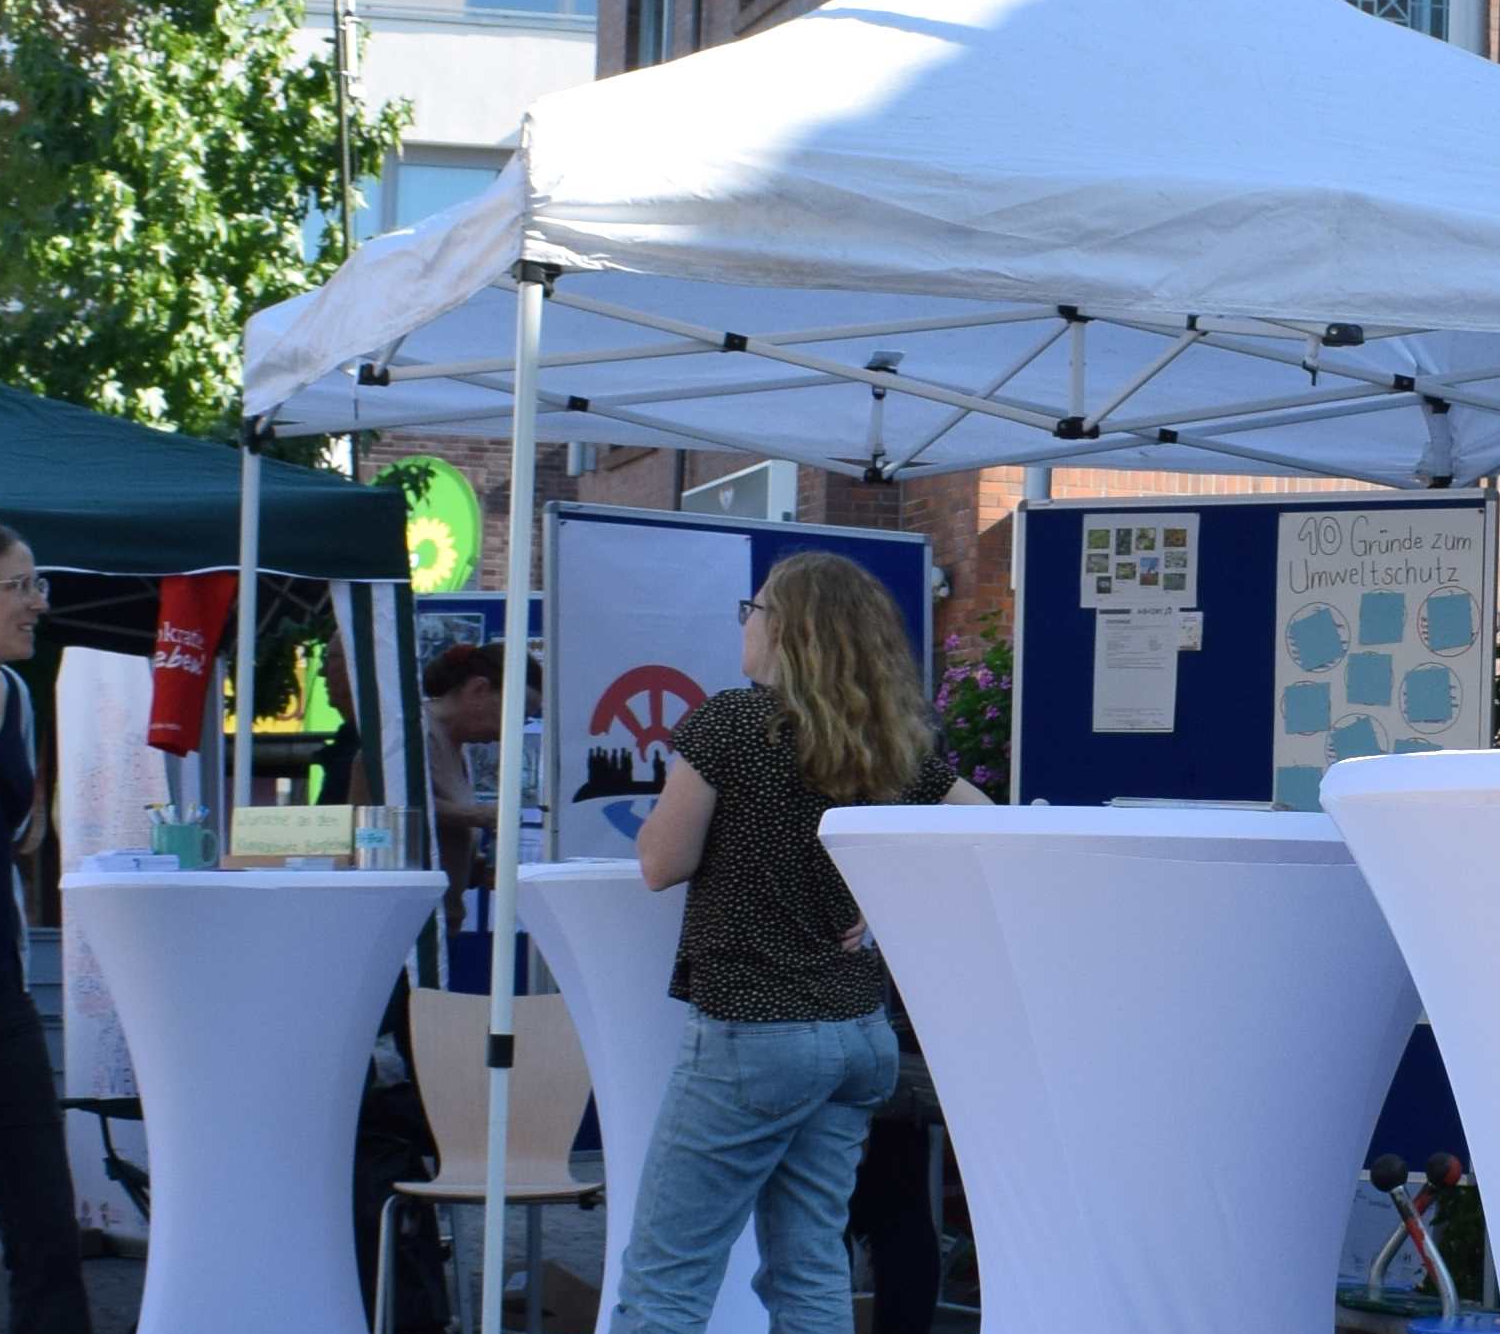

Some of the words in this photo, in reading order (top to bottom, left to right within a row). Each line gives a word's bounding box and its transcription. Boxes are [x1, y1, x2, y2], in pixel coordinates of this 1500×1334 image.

[1297, 515, 1344, 556] 10
[1350, 515, 1424, 557] Gründe
[1430, 532, 1472, 551] zum
[1288, 556, 1461, 594] Umweltschutz
